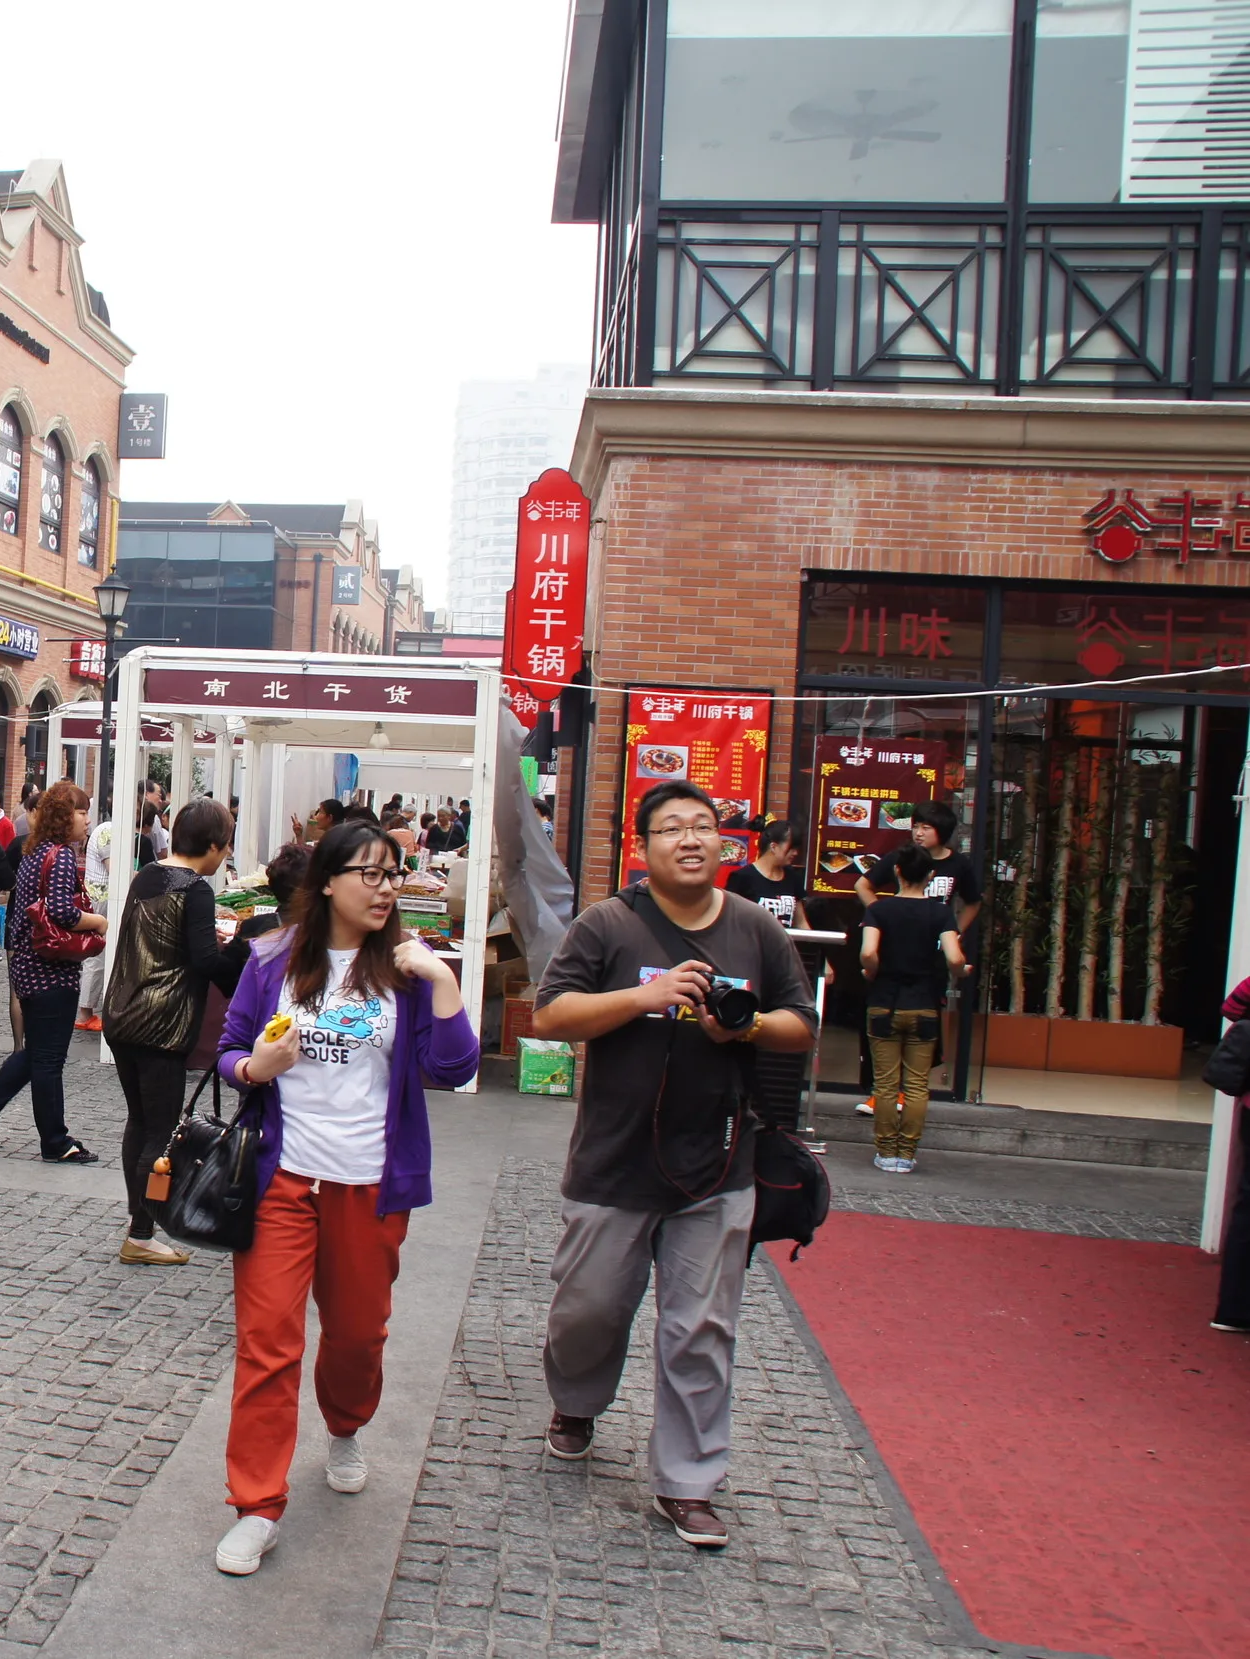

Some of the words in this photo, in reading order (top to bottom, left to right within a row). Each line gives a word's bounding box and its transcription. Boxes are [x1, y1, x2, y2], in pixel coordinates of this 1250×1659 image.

[128, 404, 156, 432] 壹
[1082, 488, 1250, 564] 谷丰
[527, 533, 569, 677] 川府干锅
[838, 606, 954, 661] 川味
[203, 678, 412, 705] 南北干货
[513, 691, 539, 714] 锅
[692, 704, 754, 720] 川府干锅
[877, 752, 925, 764] 川府干锅
[299, 1029, 346, 1047] HOLE
[723, 1116, 734, 1150] Canon
